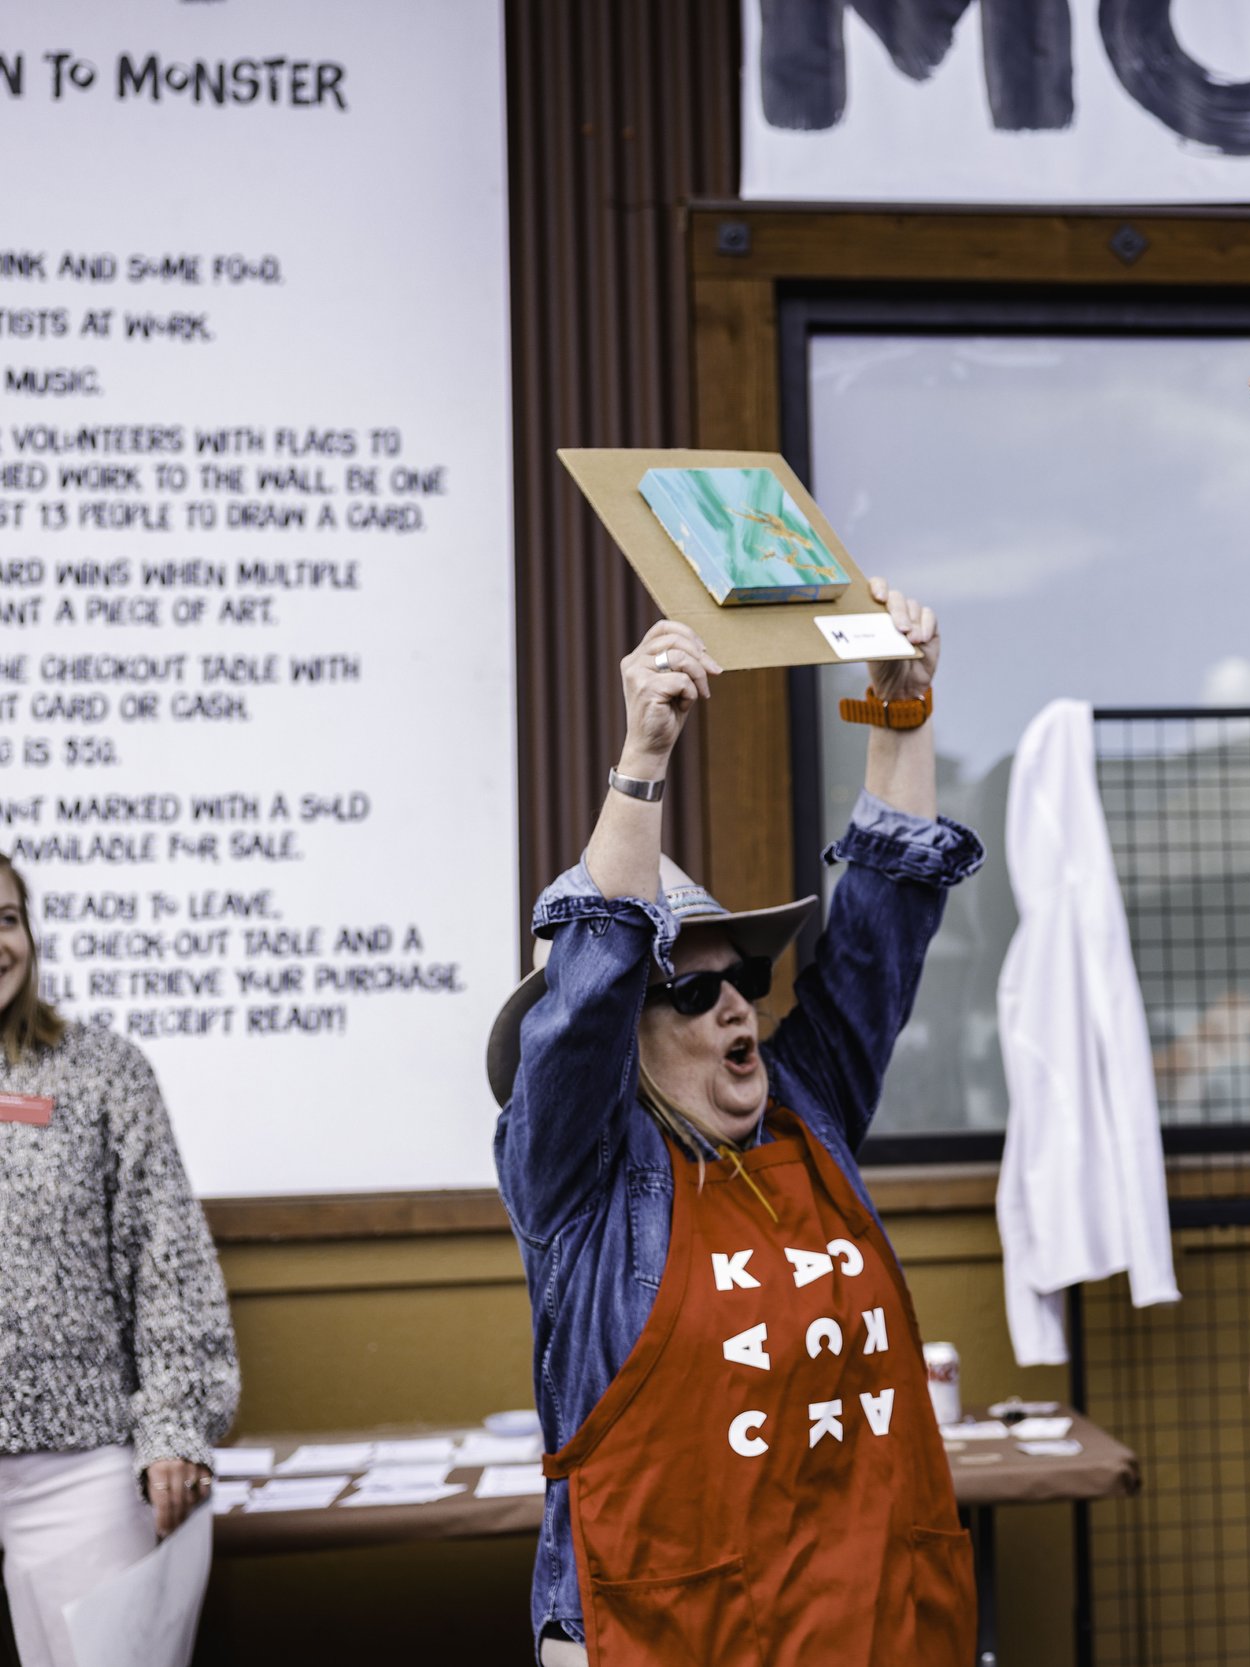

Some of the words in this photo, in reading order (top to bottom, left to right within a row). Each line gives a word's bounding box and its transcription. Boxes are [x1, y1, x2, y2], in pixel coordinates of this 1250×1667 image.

[116, 52, 347, 112] MONSTER
[0, 251, 47, 281] INK
[58, 252, 117, 283] AND
[80, 309, 114, 338] AT
[12, 425, 185, 455] VOLUNTEERS
[194, 427, 265, 455] WITH
[274, 427, 358, 457] FLAGS
[370, 428, 402, 458] TO
[59, 465, 140, 491] WORK
[156, 464, 187, 491] TO
[200, 464, 244, 493] THE
[346, 467, 378, 495] BE
[390, 466, 446, 496] ONE
[41, 502, 68, 527] 13
[80, 502, 169, 530] PEOPLE
[187, 503, 216, 529] TO
[227, 503, 306, 529] DRAW
[317, 503, 336, 528] A
[57, 560, 130, 590] WINS
[142, 560, 226, 589] WHEN
[236, 560, 358, 590] MULTIPLE
[56, 597, 75, 623] A
[87, 596, 158, 625] PIECE
[173, 597, 205, 625] OF
[41, 655, 186, 684] CHECKOUT
[202, 654, 278, 685] TABLE
[289, 654, 361, 685] WITH
[32, 694, 109, 722] CARD
[120, 692, 160, 722] OR
[24, 739, 50, 766] IS
[57, 794, 182, 824] MARKED
[190, 792, 260, 823] WITH
[269, 793, 290, 822] A
[299, 791, 371, 823] SOLD
[13, 832, 154, 864] AVAILABLE
[168, 833, 219, 864] FOR
[43, 892, 137, 922] READY
[72, 930, 228, 958] CHECK-OUT
[244, 927, 321, 957] TABLE
[334, 925, 394, 956] AND
[402, 922, 424, 953] A
[89, 969, 220, 997] RETRIEVE
[236, 966, 303, 995] YOUR
[127, 1006, 235, 1036] RECEIPT
[246, 1004, 347, 1036] READY!
